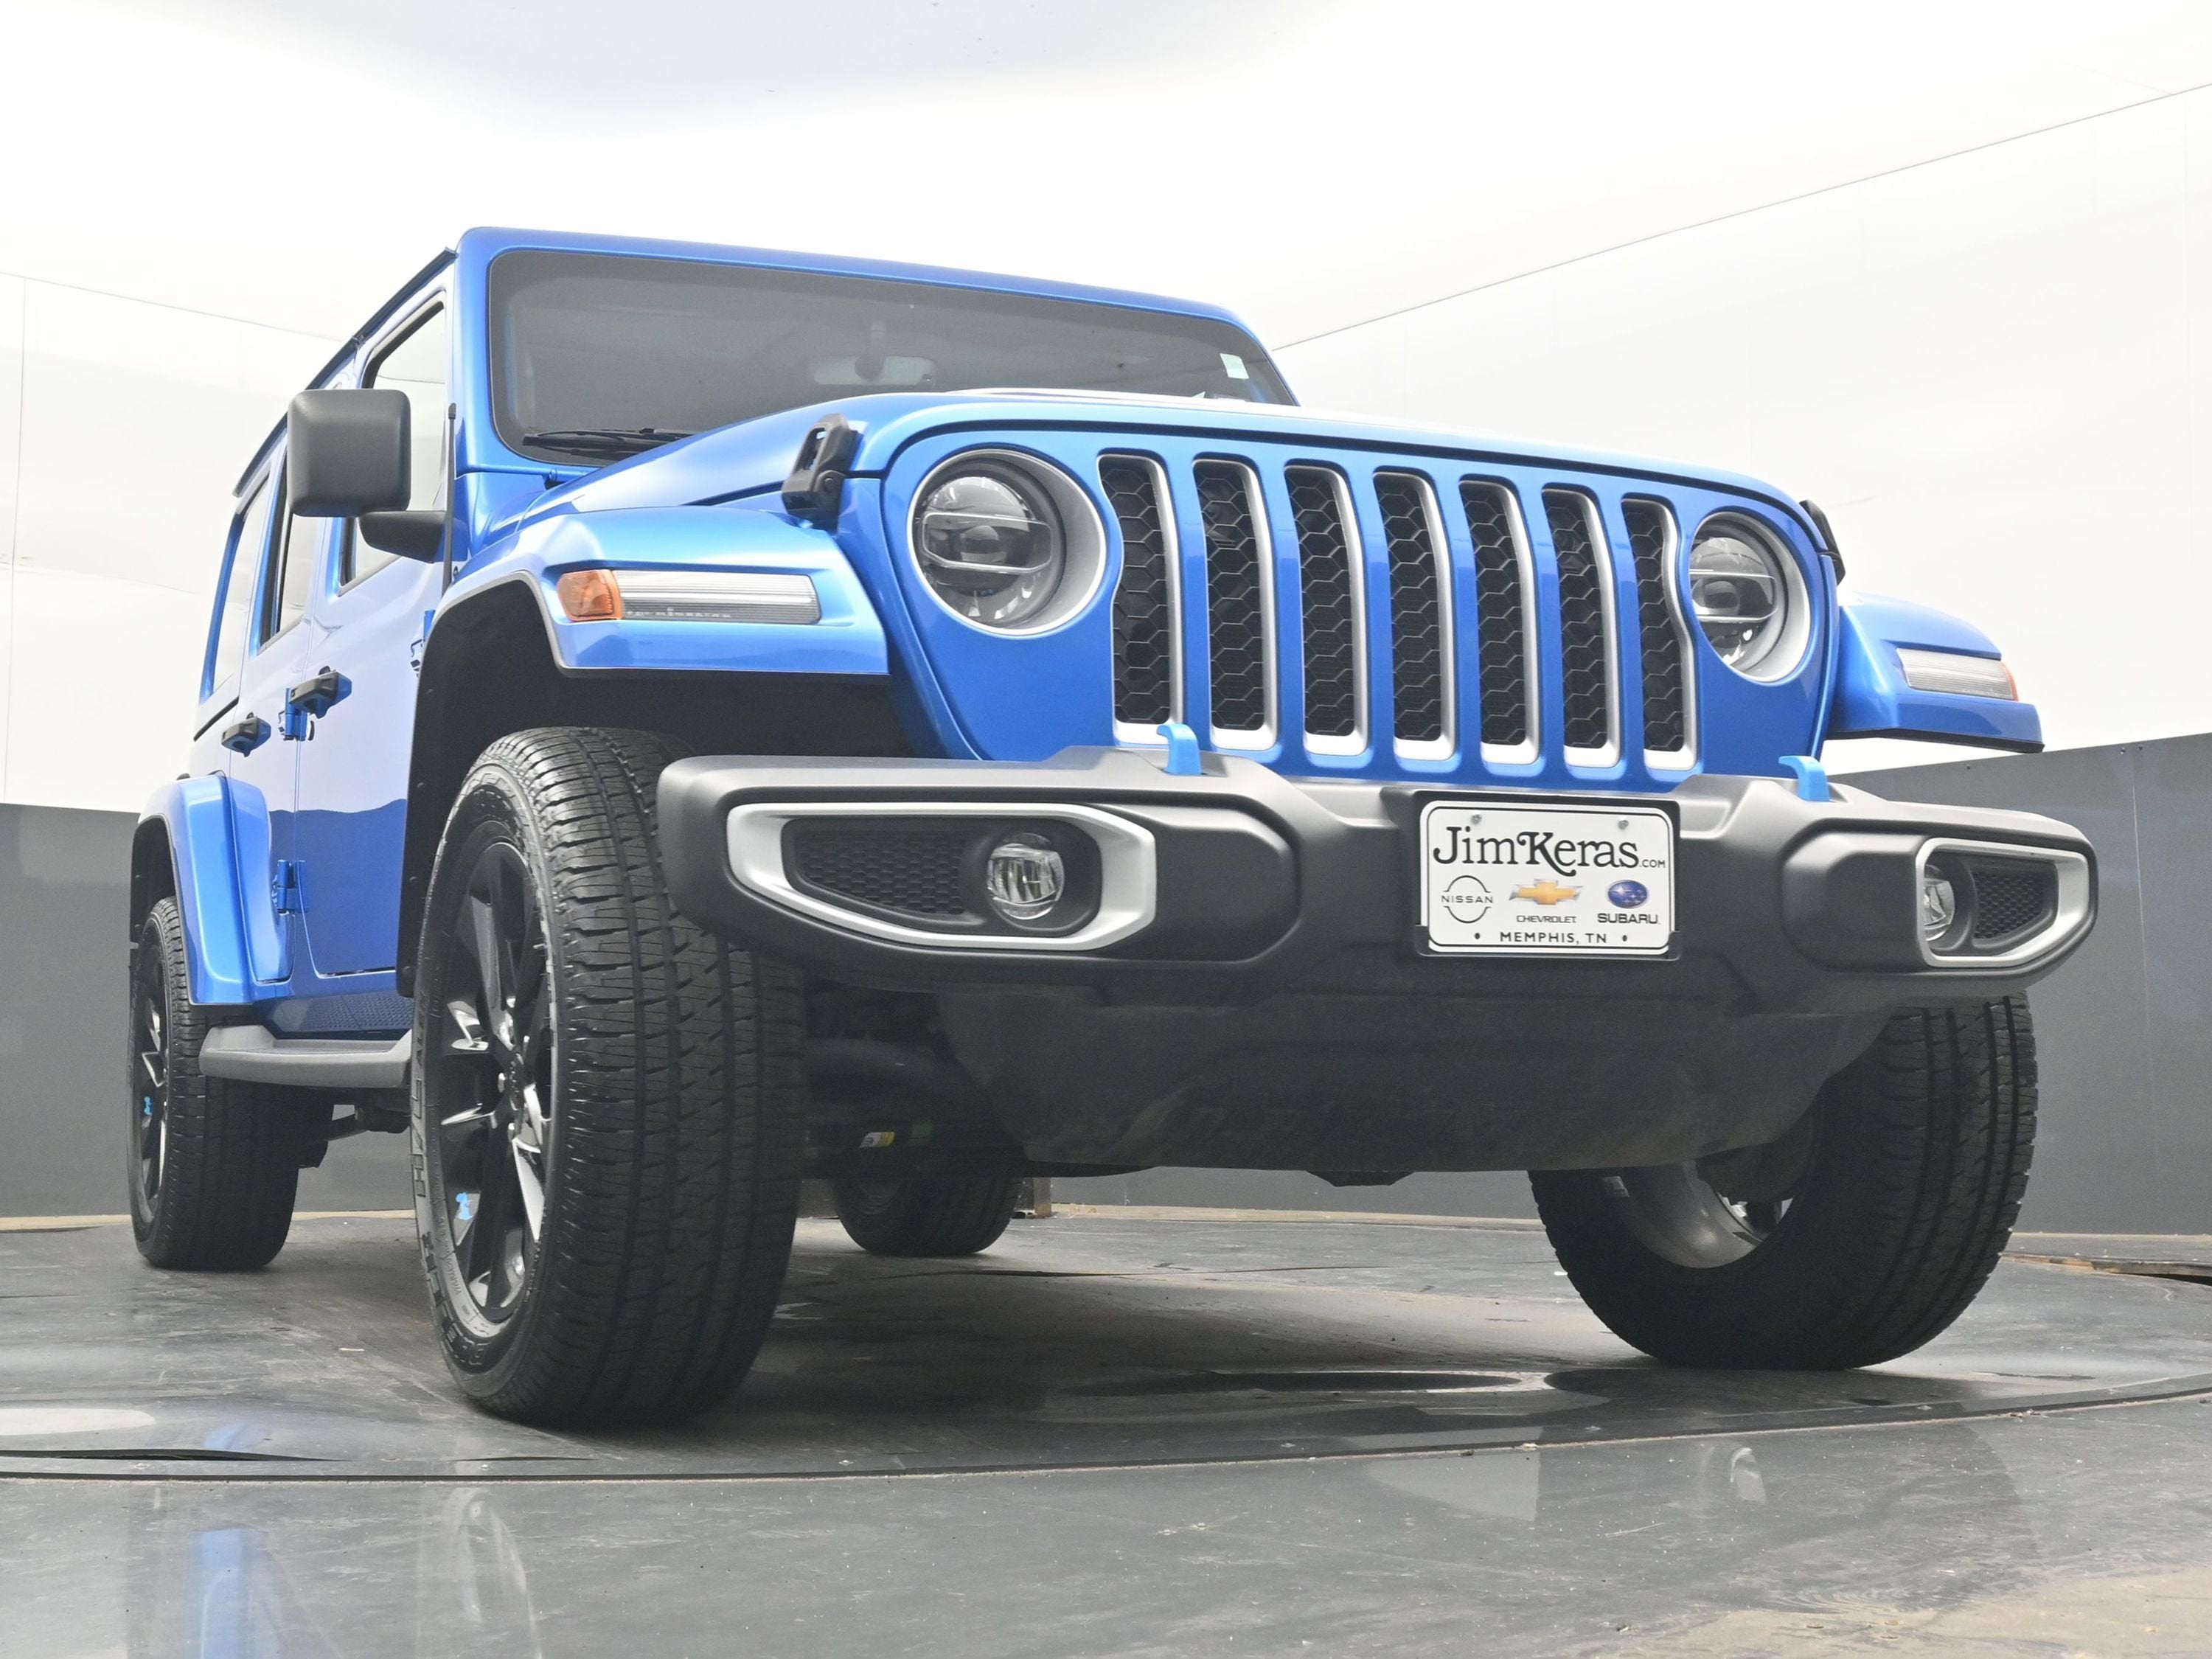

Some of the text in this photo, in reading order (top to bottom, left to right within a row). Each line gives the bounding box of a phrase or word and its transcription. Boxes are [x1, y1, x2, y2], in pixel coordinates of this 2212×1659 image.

[1441, 895, 1493, 904] NISSAN
[1516, 915, 1576, 923] CHEVROLET
[1597, 913, 1658, 924] SUBARU
[1500, 932, 1607, 945] MEMPHIS, TN
